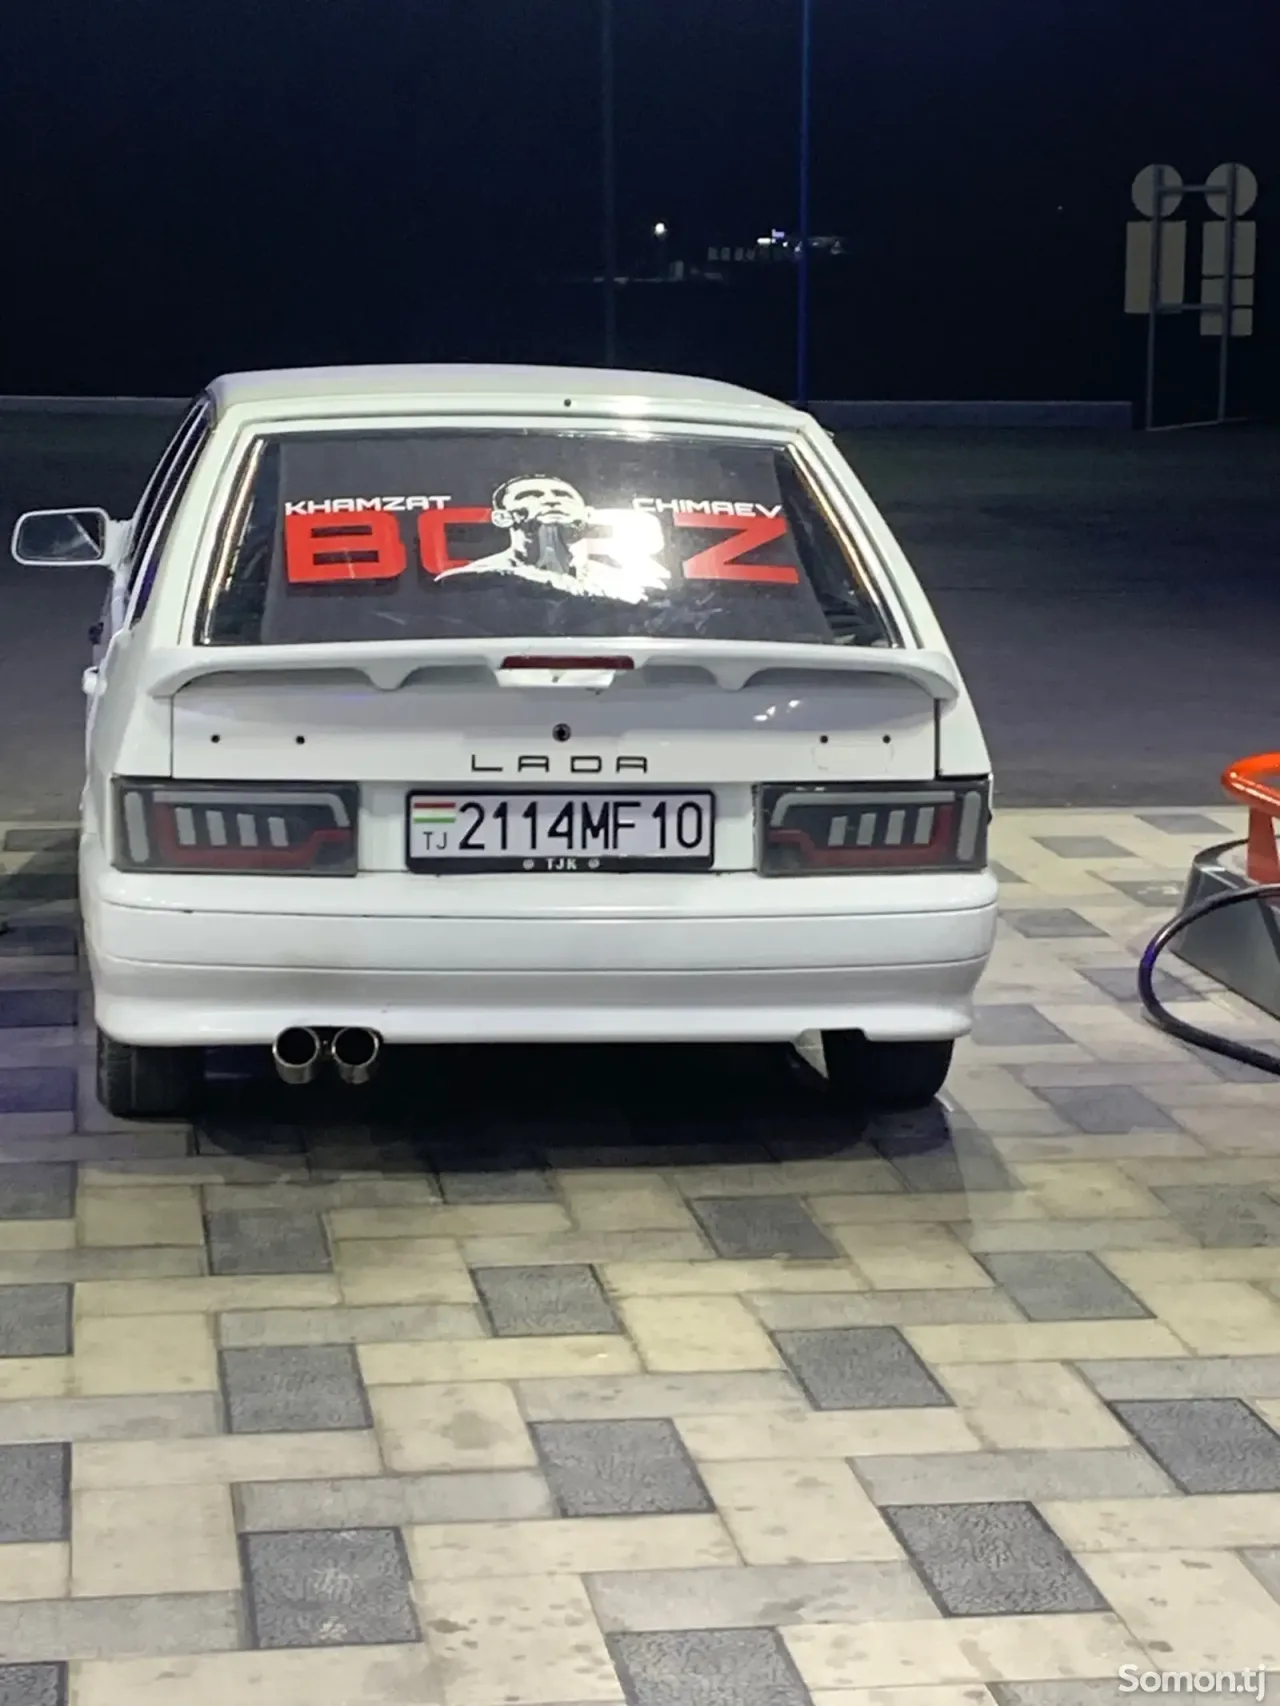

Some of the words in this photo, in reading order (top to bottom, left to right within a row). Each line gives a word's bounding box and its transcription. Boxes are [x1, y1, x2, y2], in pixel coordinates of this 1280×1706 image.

[284, 495, 452, 516] KHAMZAT
[632, 498, 784, 518] CHIMAEV
[471, 754, 648, 774] LADA
[423, 831, 448, 850] TJ
[545, 858, 578, 870] TJK
